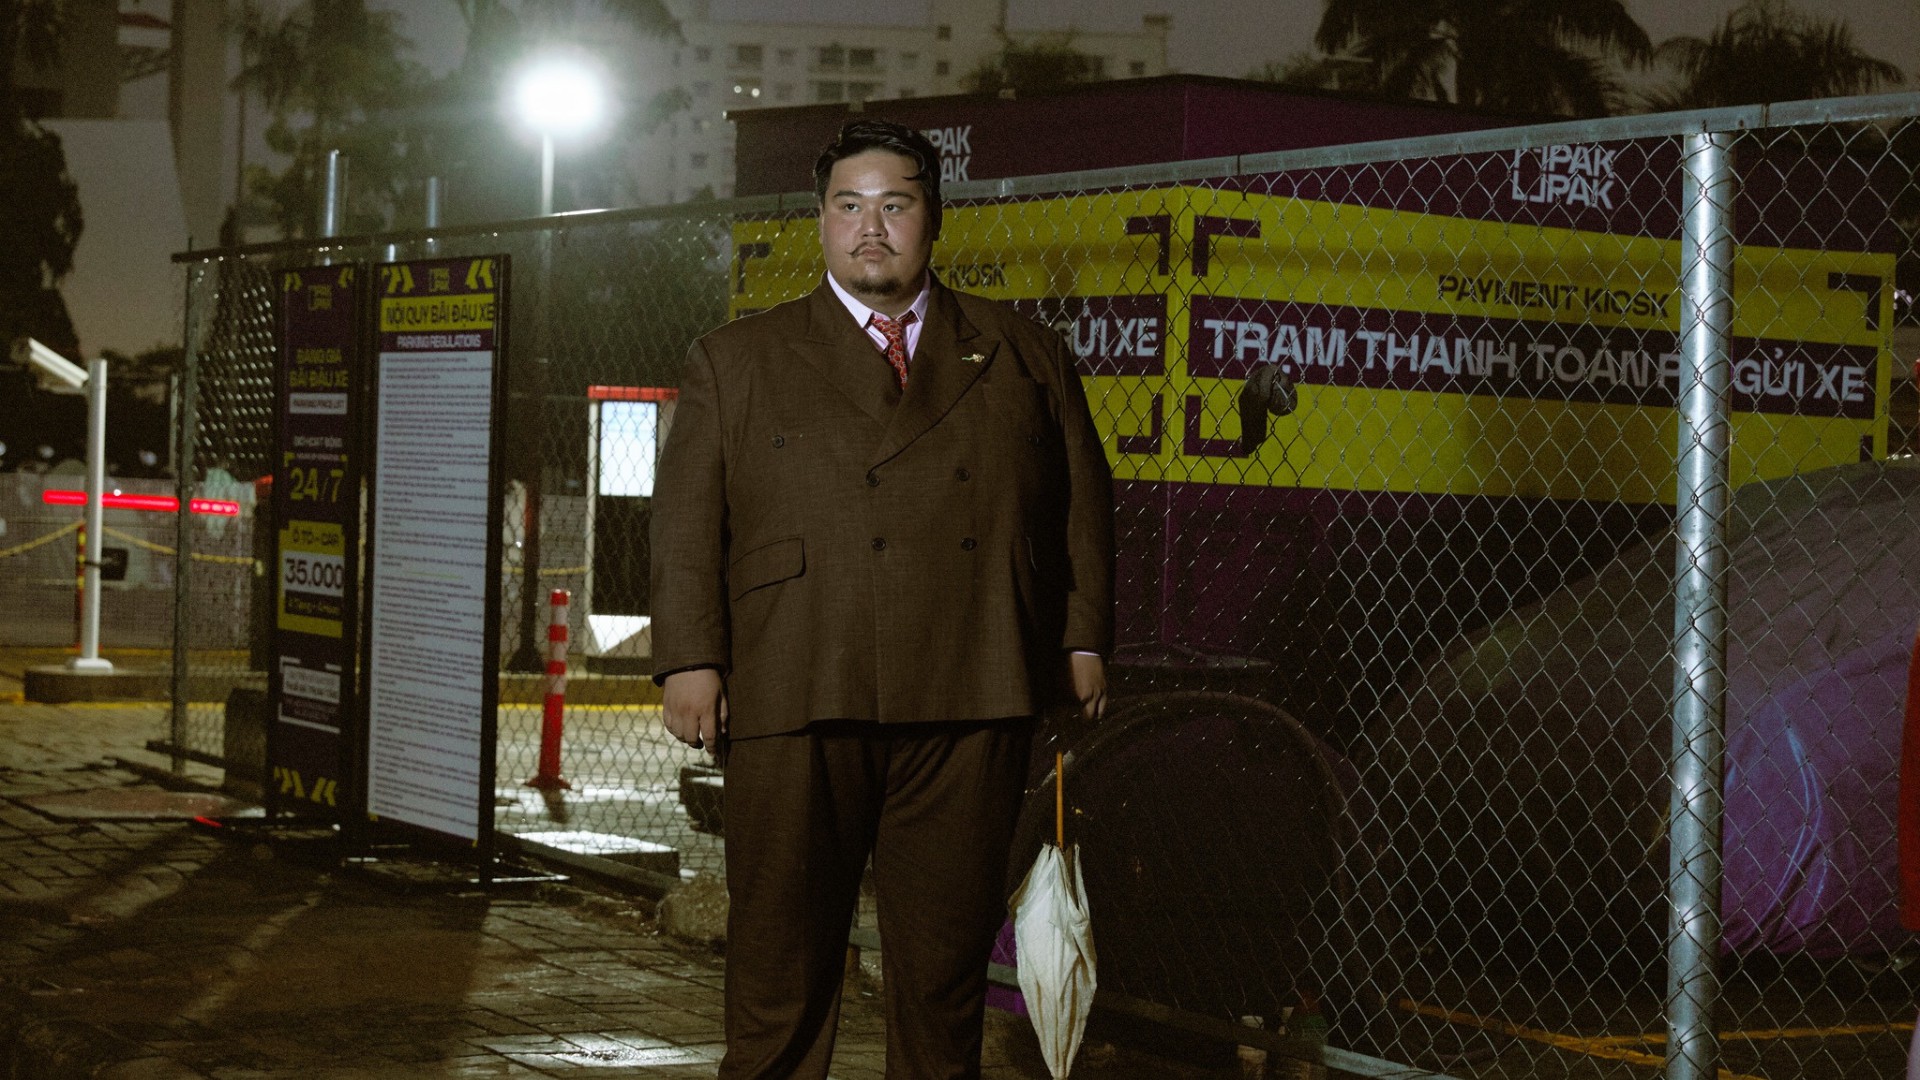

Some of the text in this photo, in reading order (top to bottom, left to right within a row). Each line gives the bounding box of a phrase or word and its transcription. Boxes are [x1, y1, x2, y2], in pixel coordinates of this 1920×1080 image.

[948, 262, 1006, 288] KIOSK
[1439, 274, 1669, 319] PAYMENT KIOSK
[1113, 317, 1158, 357] XE
[1203, 318, 1346, 374] TRẠM
[1356, 331, 1517, 379] THANH
[1530, 339, 1650, 389] TOÁN
[1815, 361, 1866, 402] XE
[289, 467, 344, 503] 24/7
[285, 558, 345, 589] 35.000
